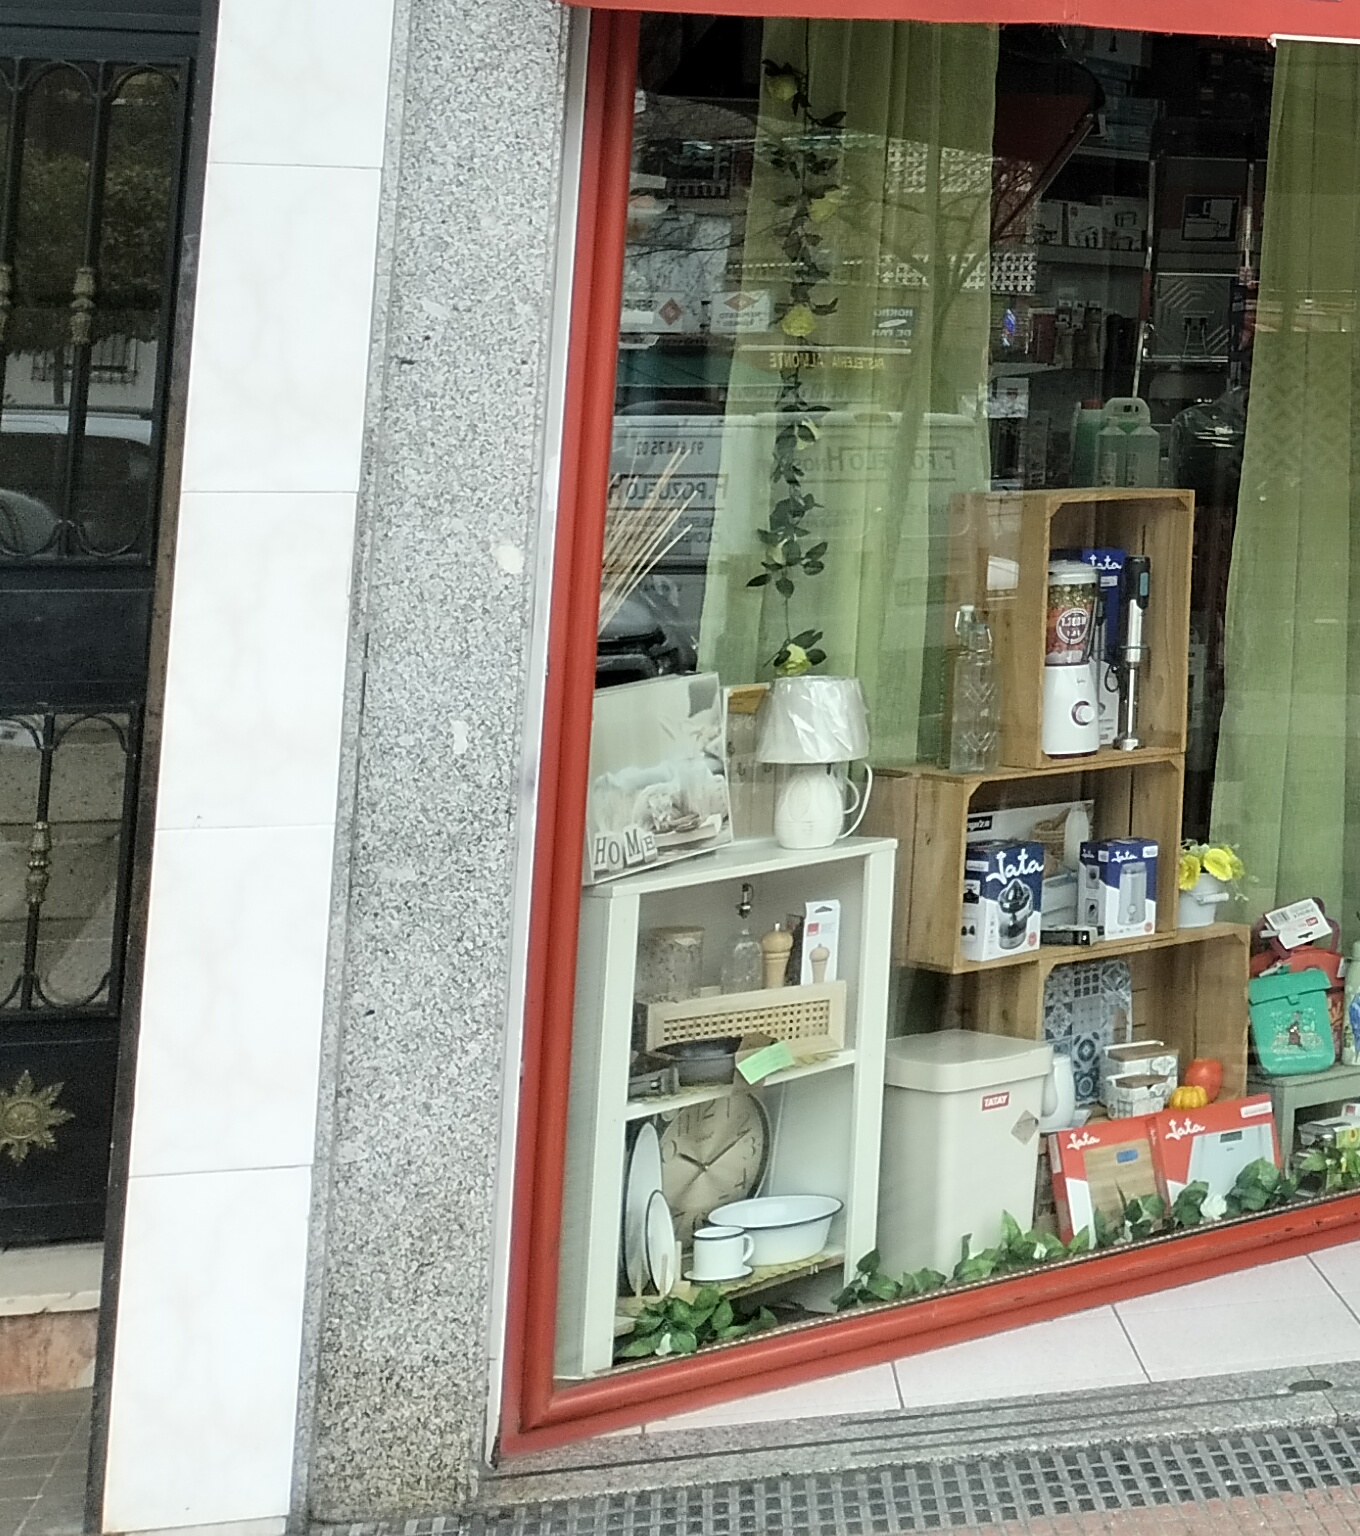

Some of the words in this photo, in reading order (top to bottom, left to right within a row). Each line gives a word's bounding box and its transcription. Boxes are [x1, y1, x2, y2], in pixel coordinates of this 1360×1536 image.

[594, 829, 655, 865] HOME
[986, 849, 1044, 886] Jata
[984, 1095, 1008, 1107] TATAY
[1067, 1131, 1100, 1150] Jata
[1164, 1117, 1205, 1141] Jata
